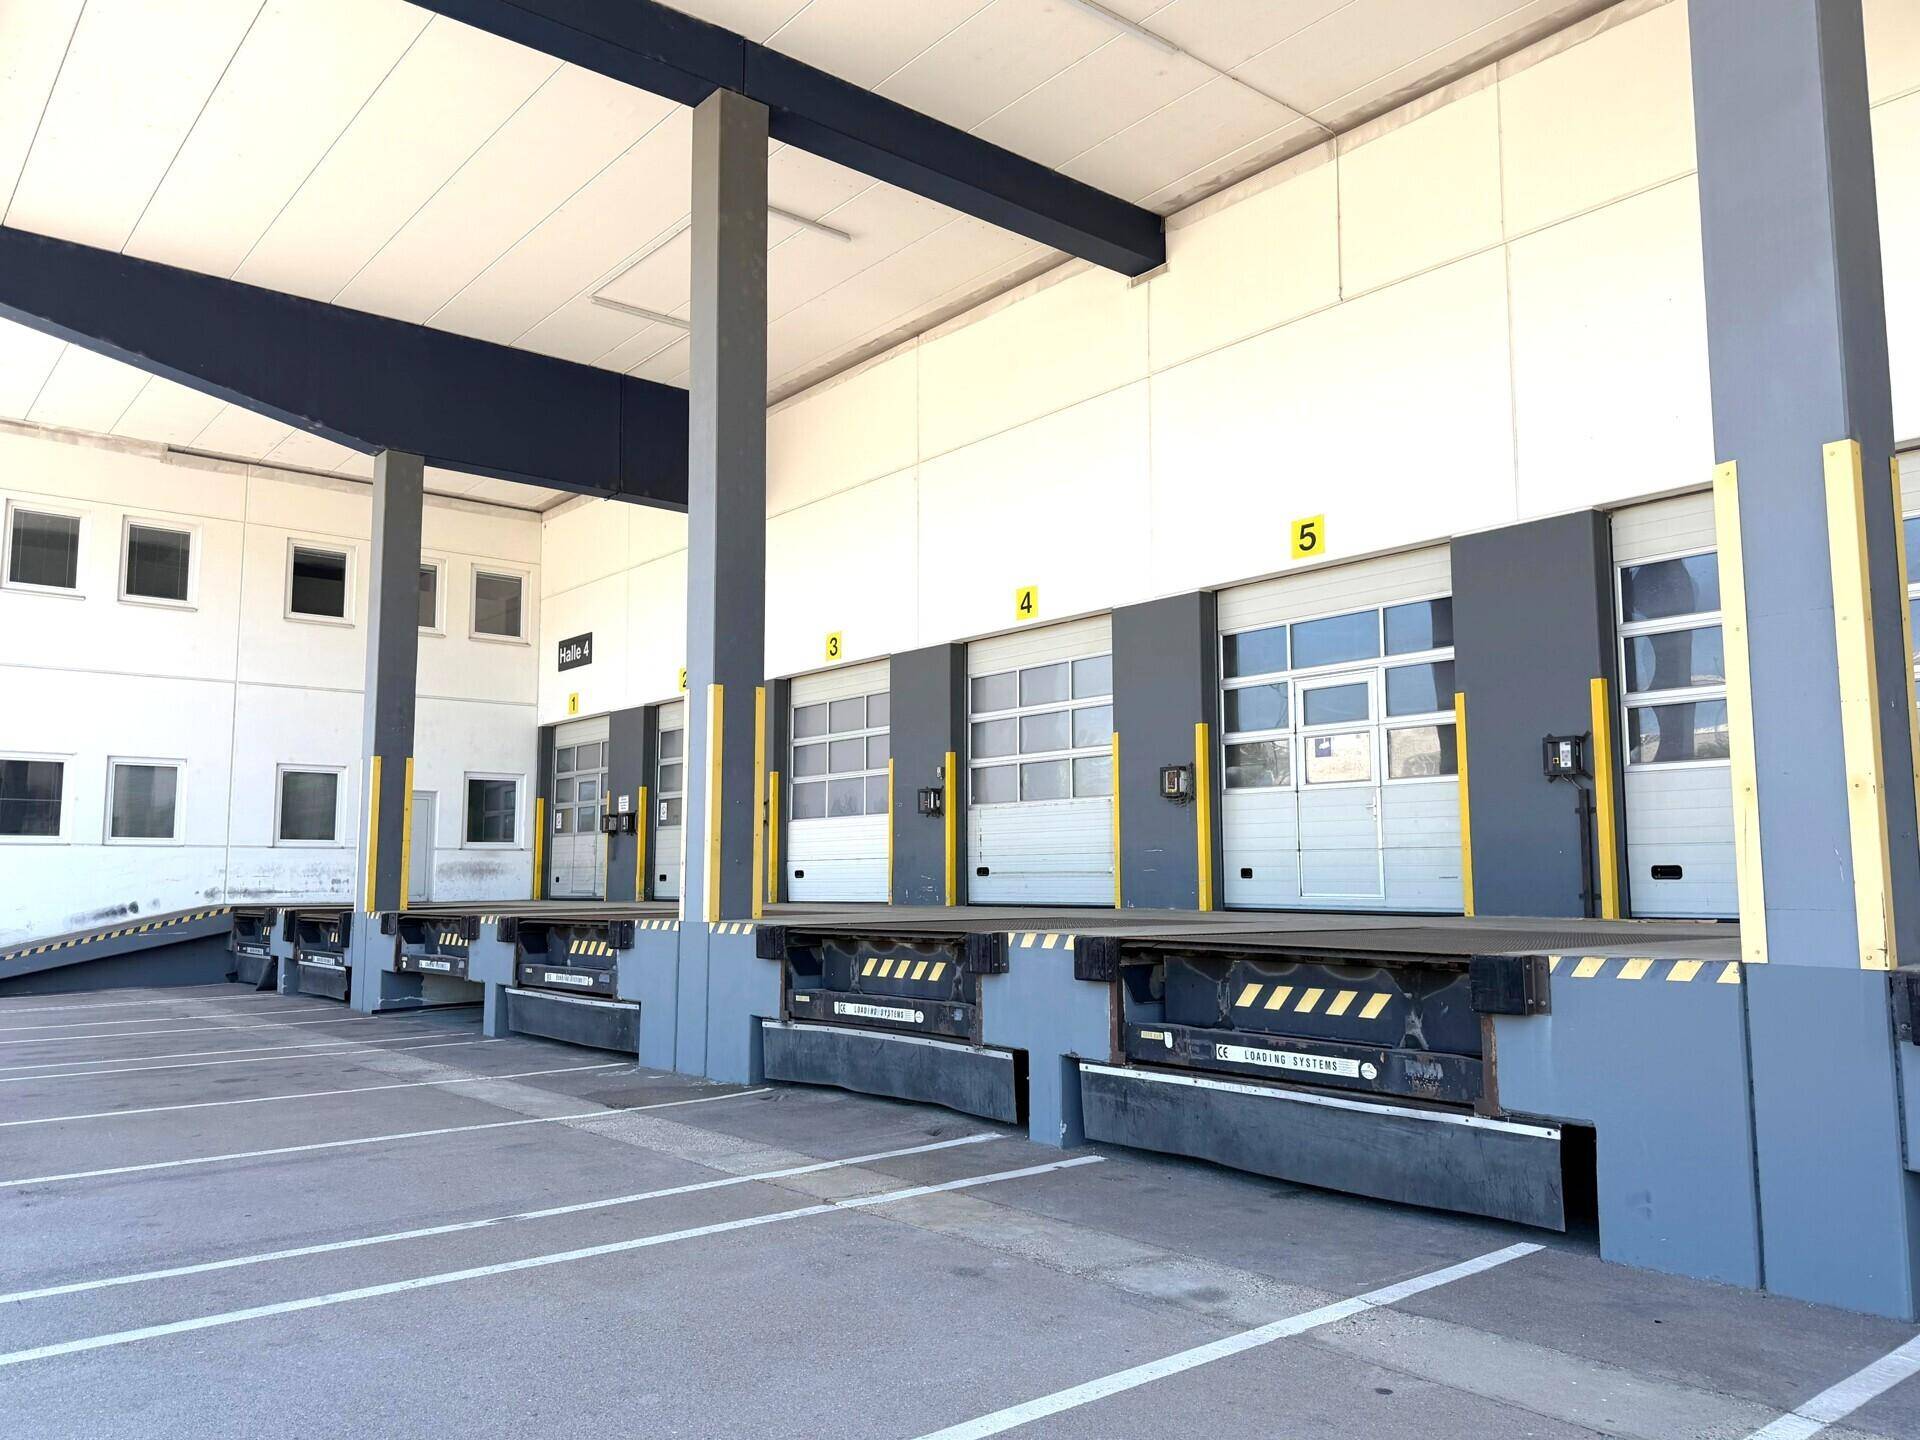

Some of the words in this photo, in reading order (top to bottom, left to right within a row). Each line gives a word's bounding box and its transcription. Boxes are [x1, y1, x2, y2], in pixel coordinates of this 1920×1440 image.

[1299, 522, 1316, 551] 5
[1020, 591, 1032, 613] 4
[559, 644, 582, 664] Halle
[583, 640, 590, 657] 4
[830, 637, 838, 656] 3
[571, 696, 576, 711] 1
[1244, 1050, 1286, 1065] LOADING
[1293, 1057, 1338, 1071] SYSTEMS
